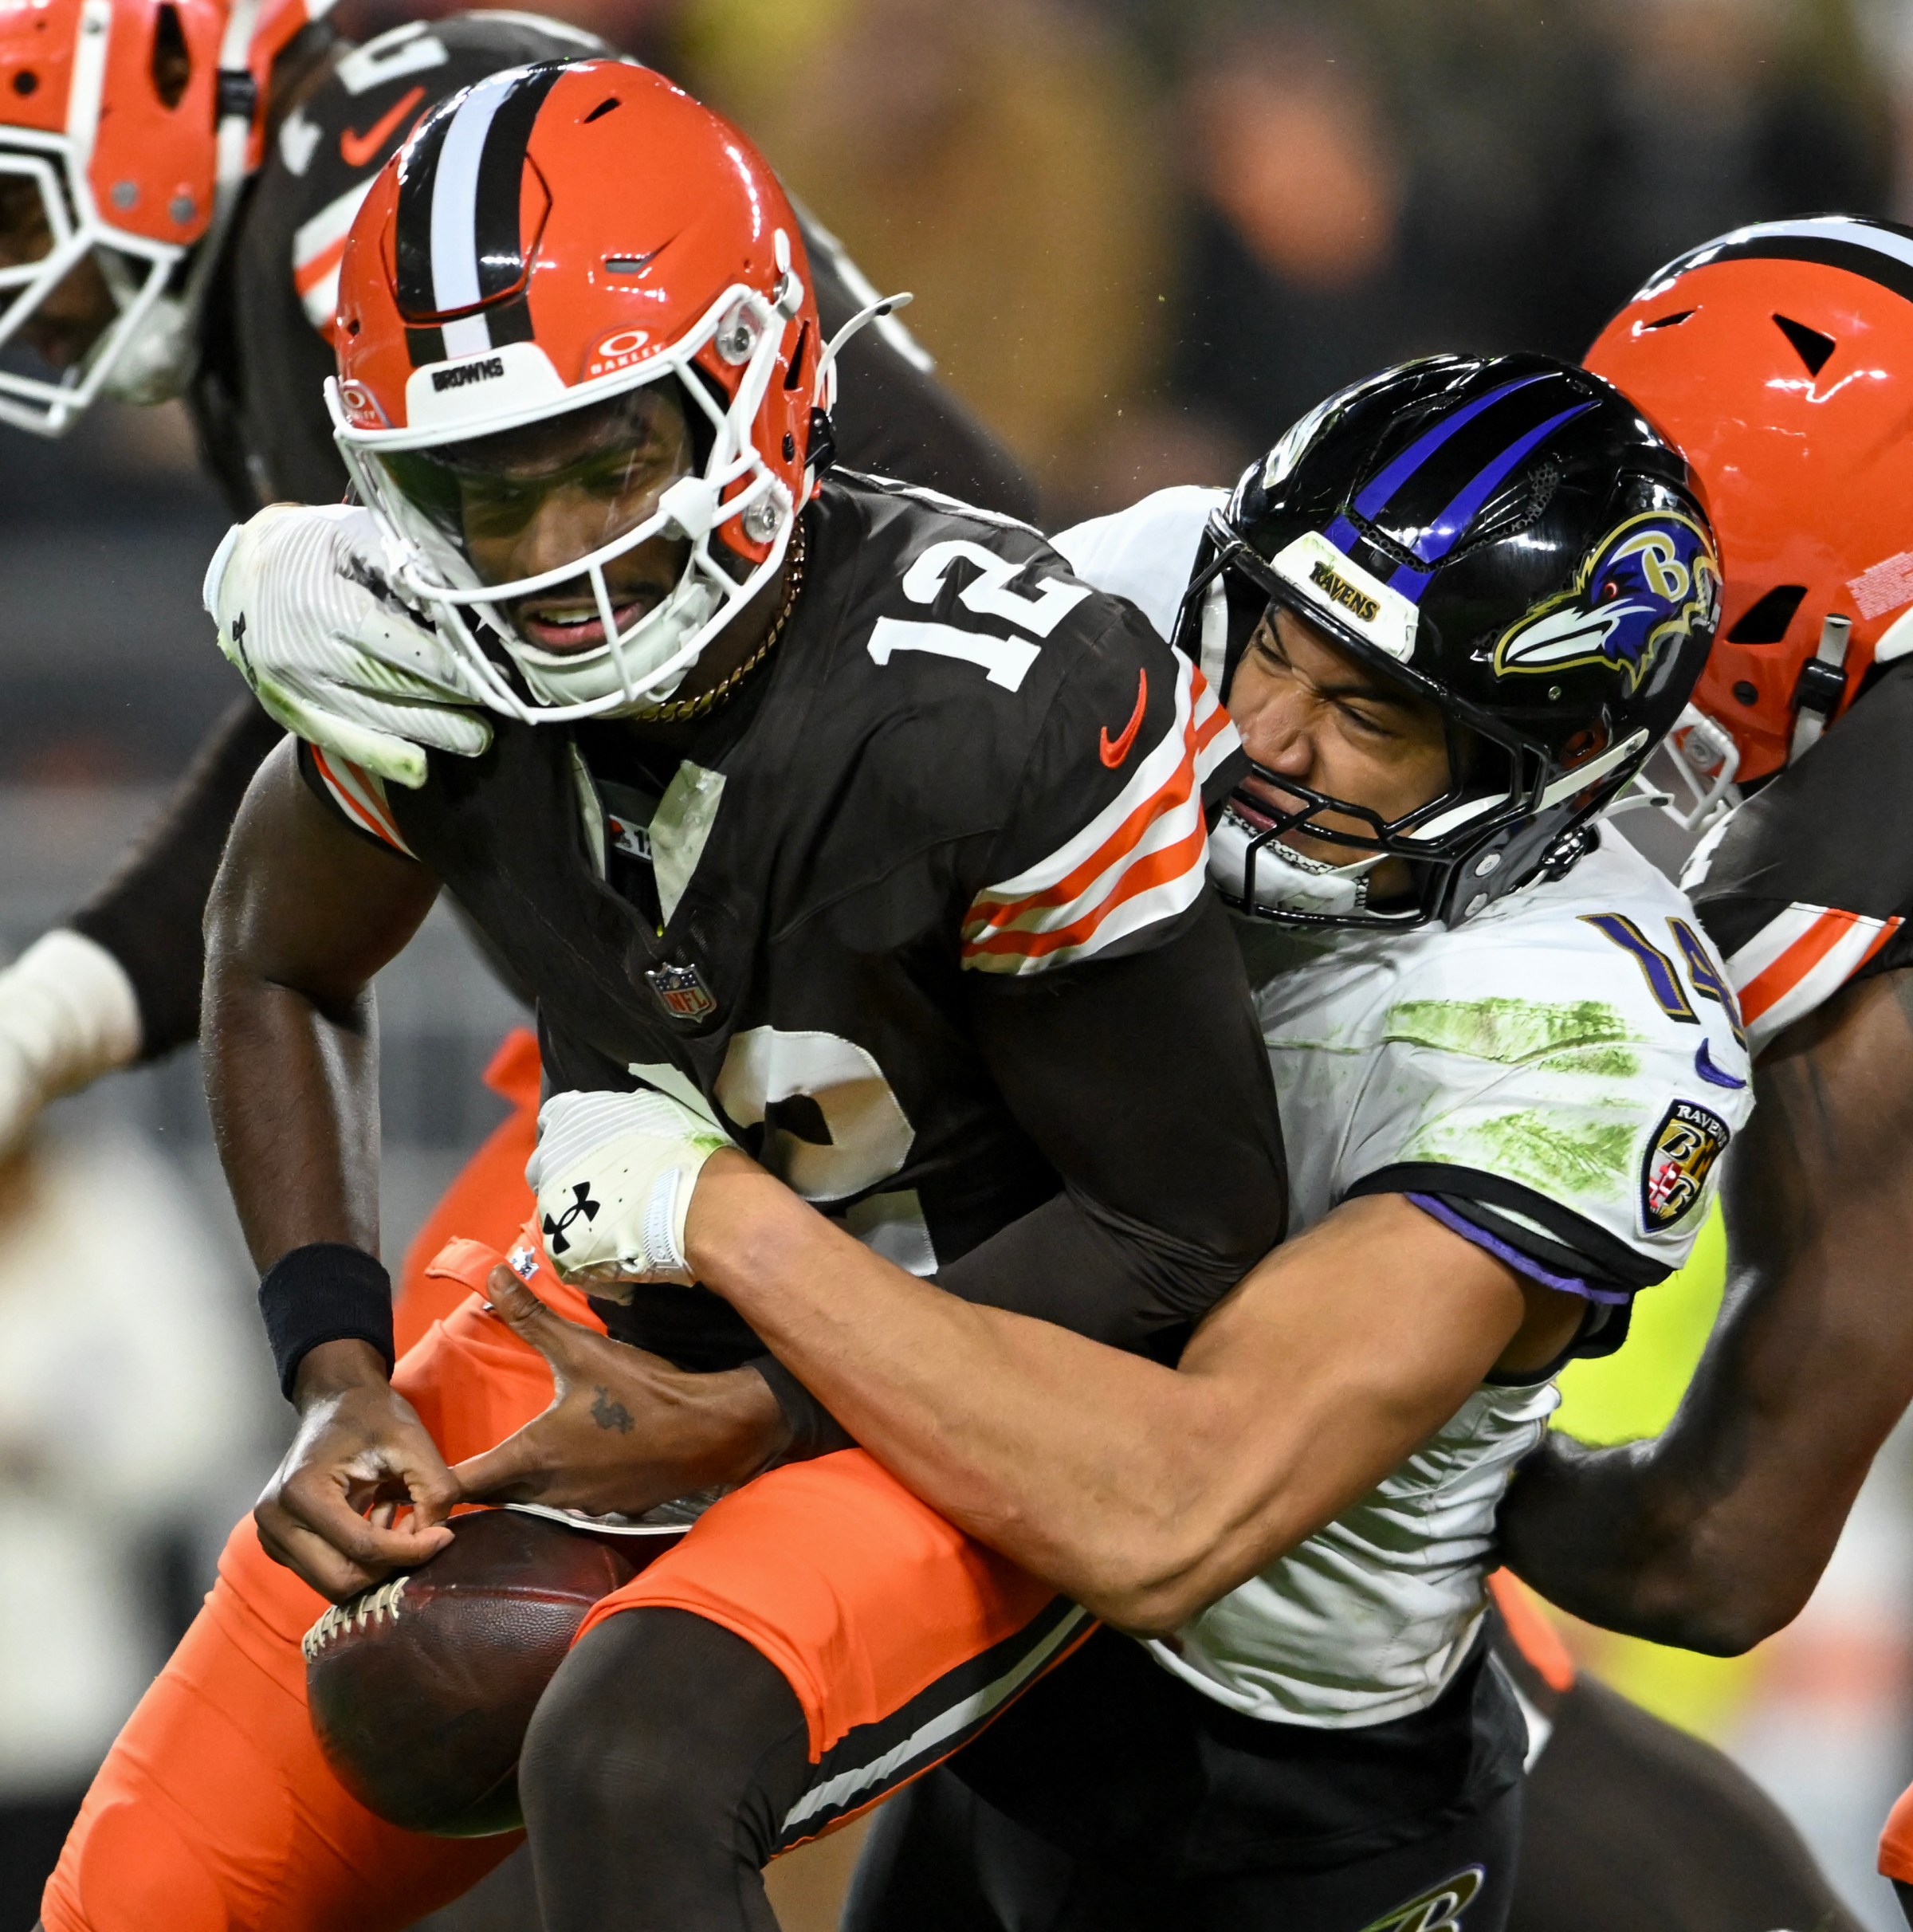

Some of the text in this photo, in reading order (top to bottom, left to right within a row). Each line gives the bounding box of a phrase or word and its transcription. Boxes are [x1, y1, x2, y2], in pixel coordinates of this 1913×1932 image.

[431, 356, 505, 393] BROWNS
[590, 342, 663, 375] OAKLEY
[1606, 530, 1690, 603] B
[1308, 560, 1381, 622] RAVENS
[866, 540, 1094, 693] 12
[666, 989, 709, 1013] NFL
[1676, 1105, 1729, 1149] RAVENS
